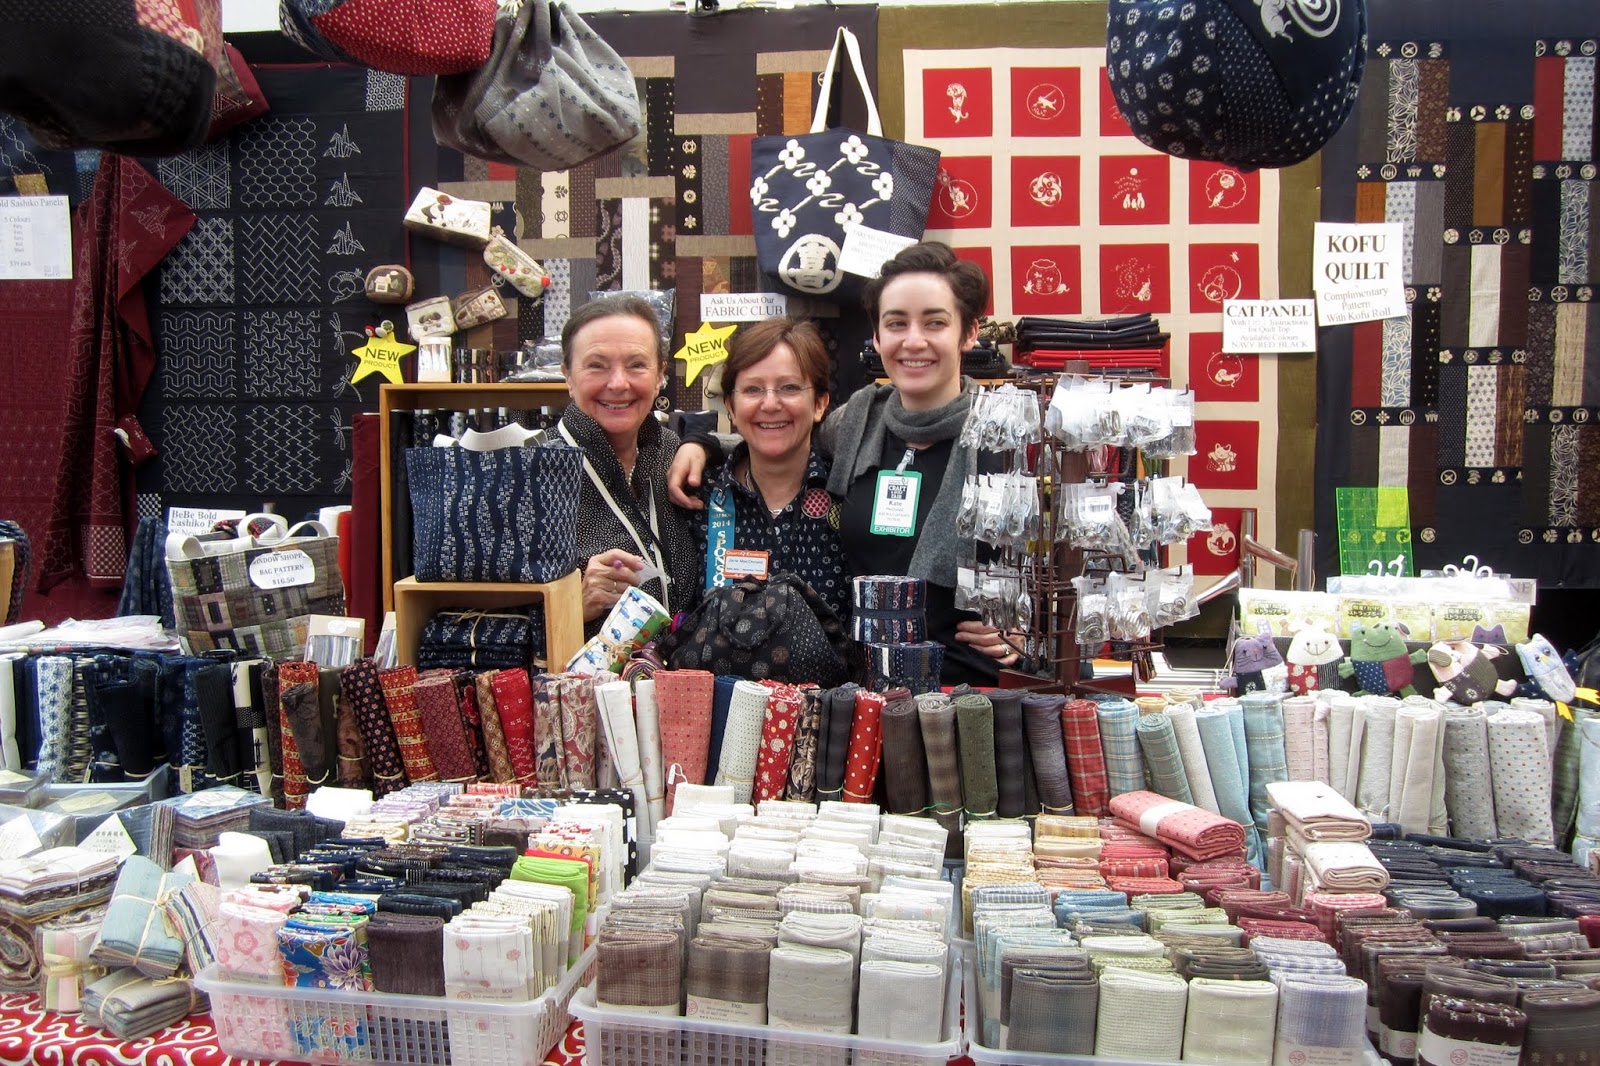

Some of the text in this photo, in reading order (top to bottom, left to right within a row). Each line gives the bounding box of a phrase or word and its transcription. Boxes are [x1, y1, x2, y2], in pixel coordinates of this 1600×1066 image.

[10, 199, 39, 208] Sashiko
[40, 198, 64, 207] Panels
[1327, 234, 1387, 253] KOFU
[1325, 262, 1389, 284] QUILT
[1324, 288, 1388, 301] Complimentary
[710, 297, 724, 305] Ask
[760, 296, 775, 304] Our
[1342, 301, 1370, 310] Pattern
[705, 305, 783, 317] FABRIC CLUB
[1226, 305, 1313, 317] CAT PANEL
[1326, 307, 1391, 323] With Kofu Roll
[687, 338, 722, 356] NEW
[365, 347, 399, 362] NEW
[690, 350, 724, 363] PRODUCT
[364, 359, 397, 369] PRODUCT
[171, 510, 217, 520] BeBe Bold
[170, 519, 205, 527] Sashiko
[712, 520, 731, 528] 2014
[874, 525, 910, 534] EXHIBITOR
[274, 564, 304, 574] PATTERN
[272, 577, 295, 585] $16.50
